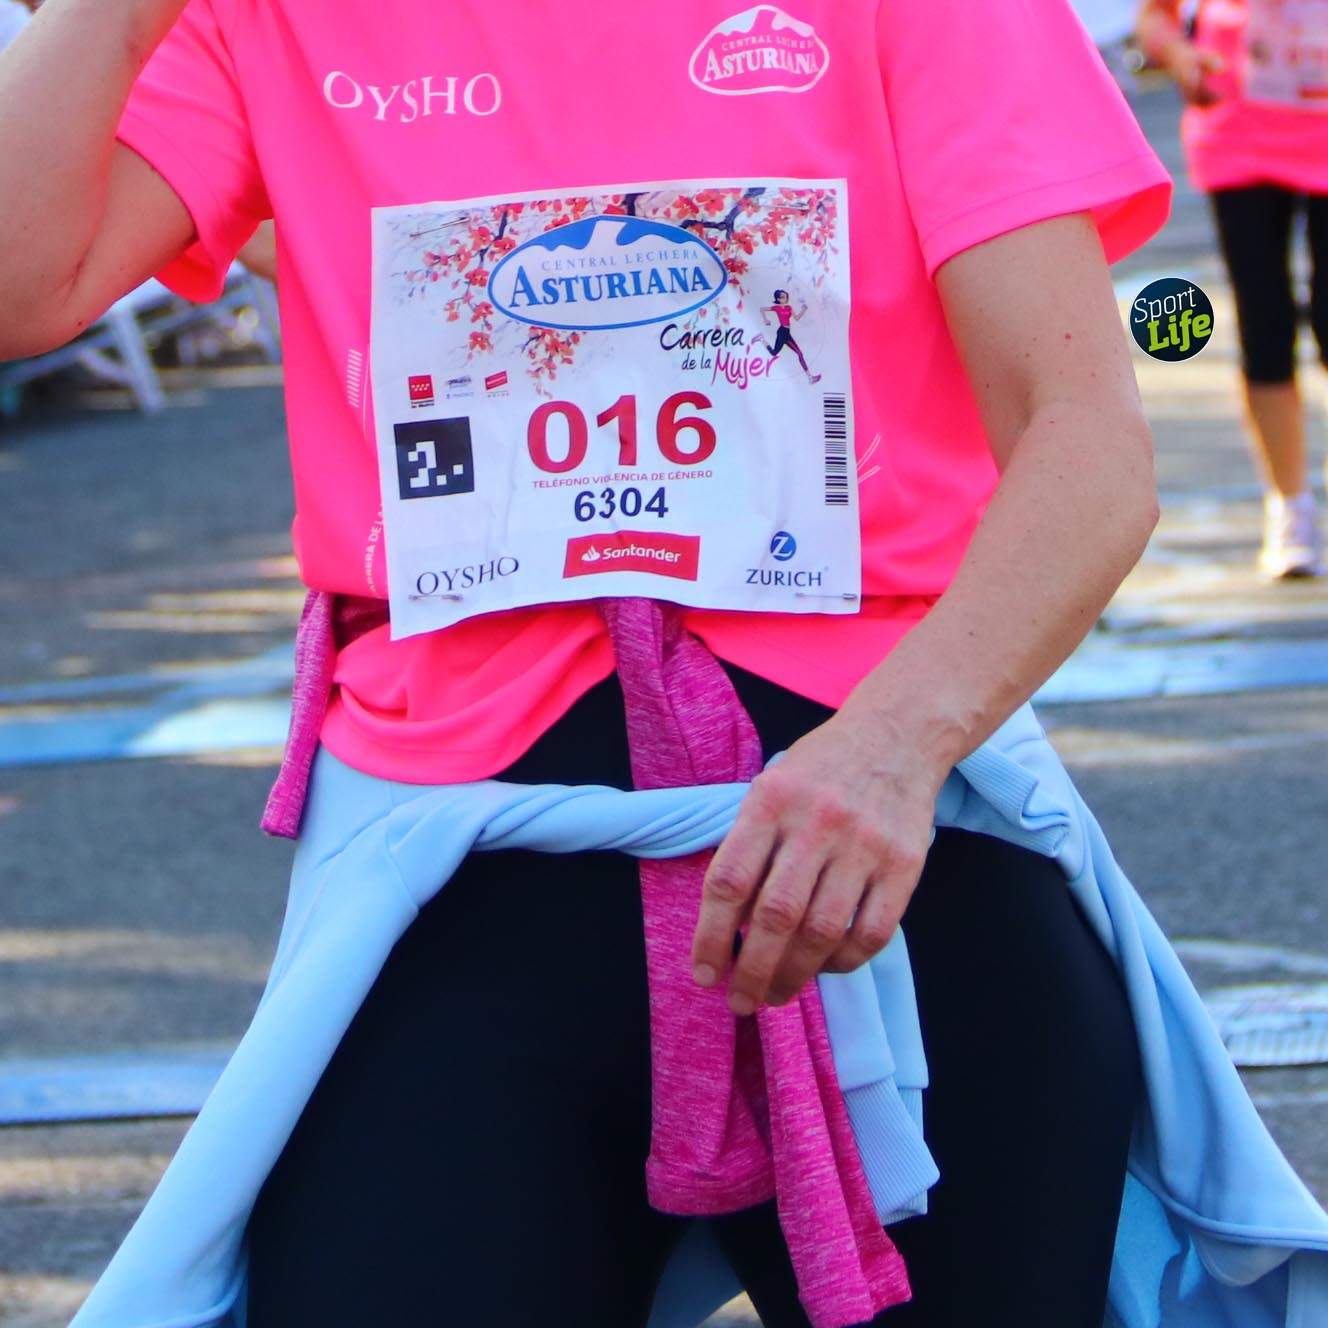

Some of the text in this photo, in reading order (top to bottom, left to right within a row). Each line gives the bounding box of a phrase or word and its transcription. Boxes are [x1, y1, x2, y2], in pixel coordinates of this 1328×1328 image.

[702, 47, 820, 83] ASTURIANA
[323, 70, 502, 123] OYSHO
[541, 249, 700, 272] CENTRAL LECHERA
[508, 264, 713, 308] ASTURIANA
[660, 323, 745, 351] Carrera
[681, 344, 781, 390] de la Mujer
[527, 390, 717, 474] 016
[592, 472, 649, 486] VIOLENCIA
[651, 472, 665, 481] DE
[574, 486, 669, 522] 6304
[602, 543, 681, 563] Santander
[416, 556, 520, 595] OYSHO
[746, 568, 822, 587] ZURICH
